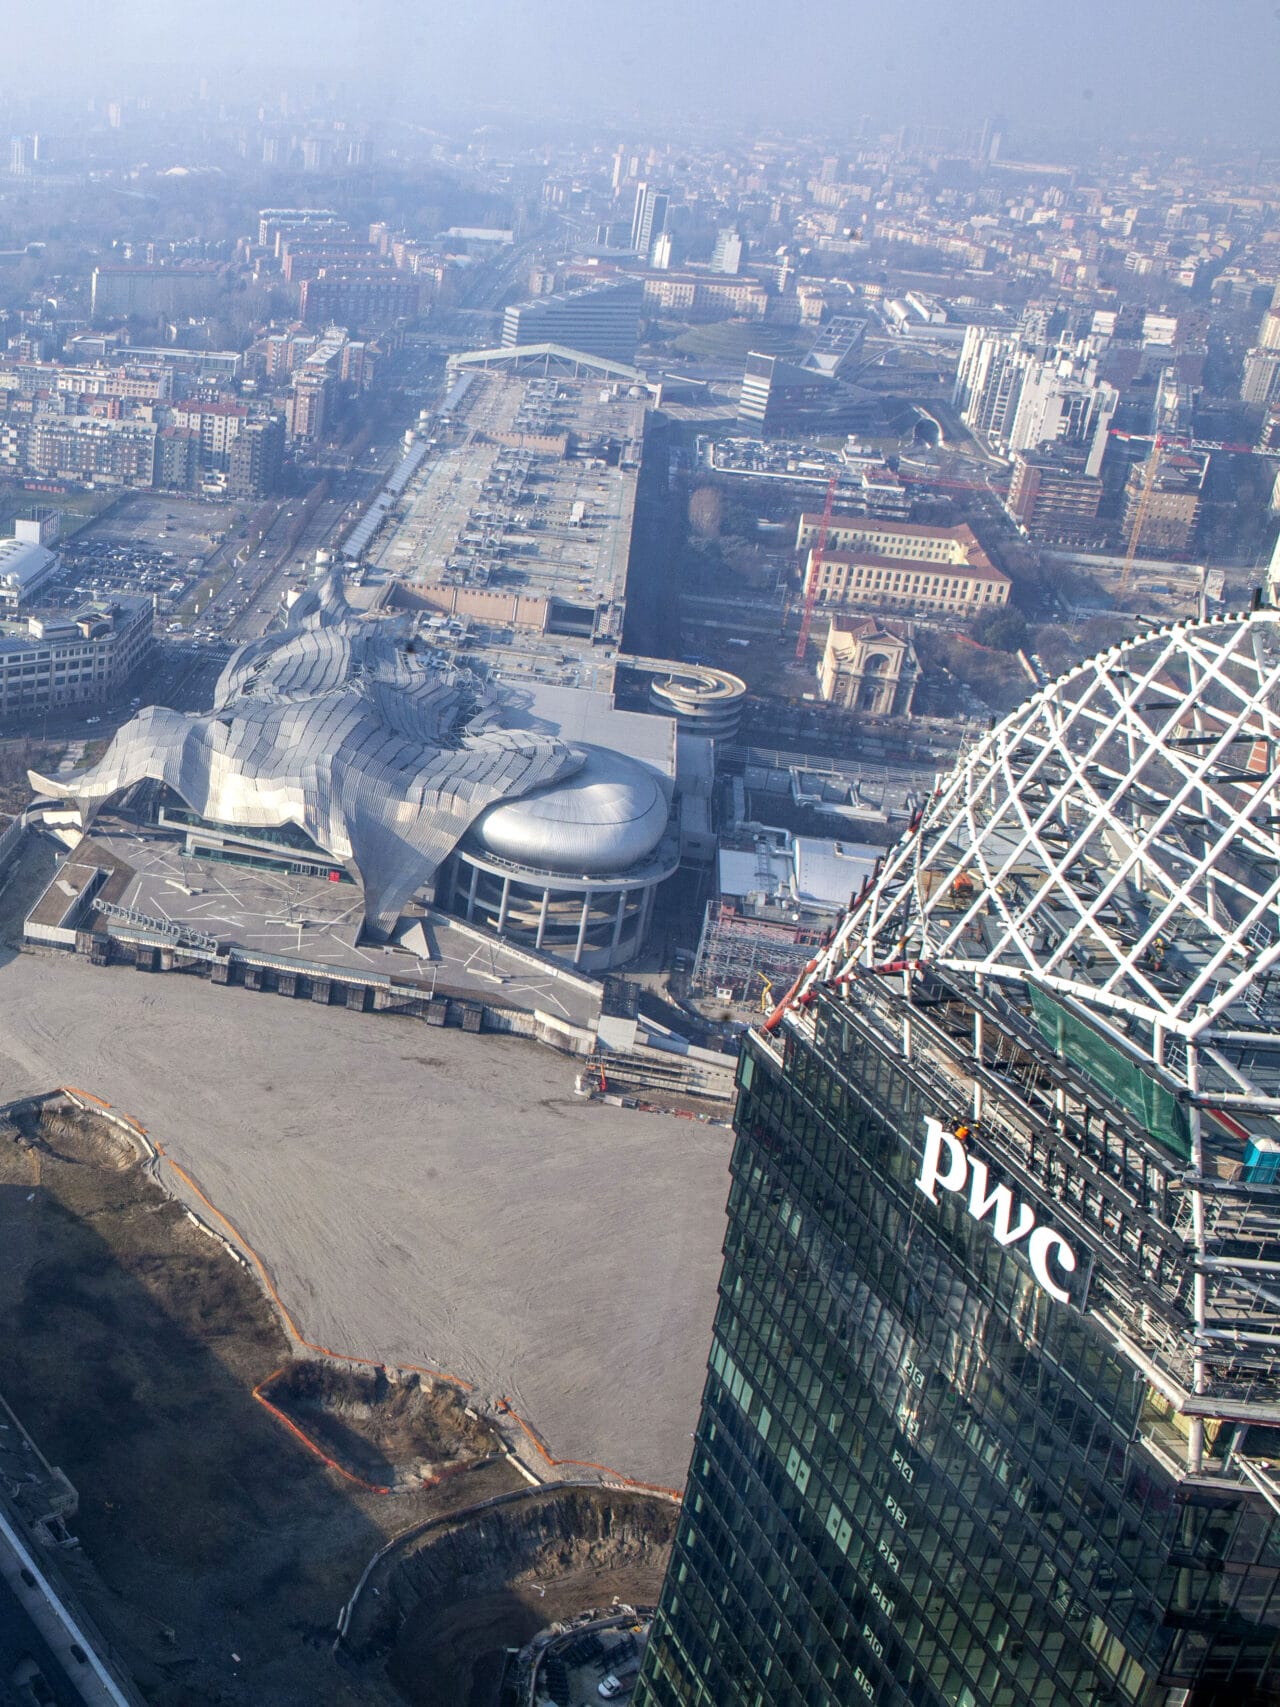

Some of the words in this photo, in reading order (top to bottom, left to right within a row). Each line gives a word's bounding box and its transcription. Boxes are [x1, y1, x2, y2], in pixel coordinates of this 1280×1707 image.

[915, 1115, 1076, 1304] pwc
[903, 1359, 923, 1387] 26
[894, 1451, 913, 1481] 24
[886, 1496, 906, 1527] 23
[880, 1541, 899, 1571] 22
[872, 1584, 892, 1616] 21
[864, 1625, 882, 1657] 20
[855, 1668, 873, 1697] 19
